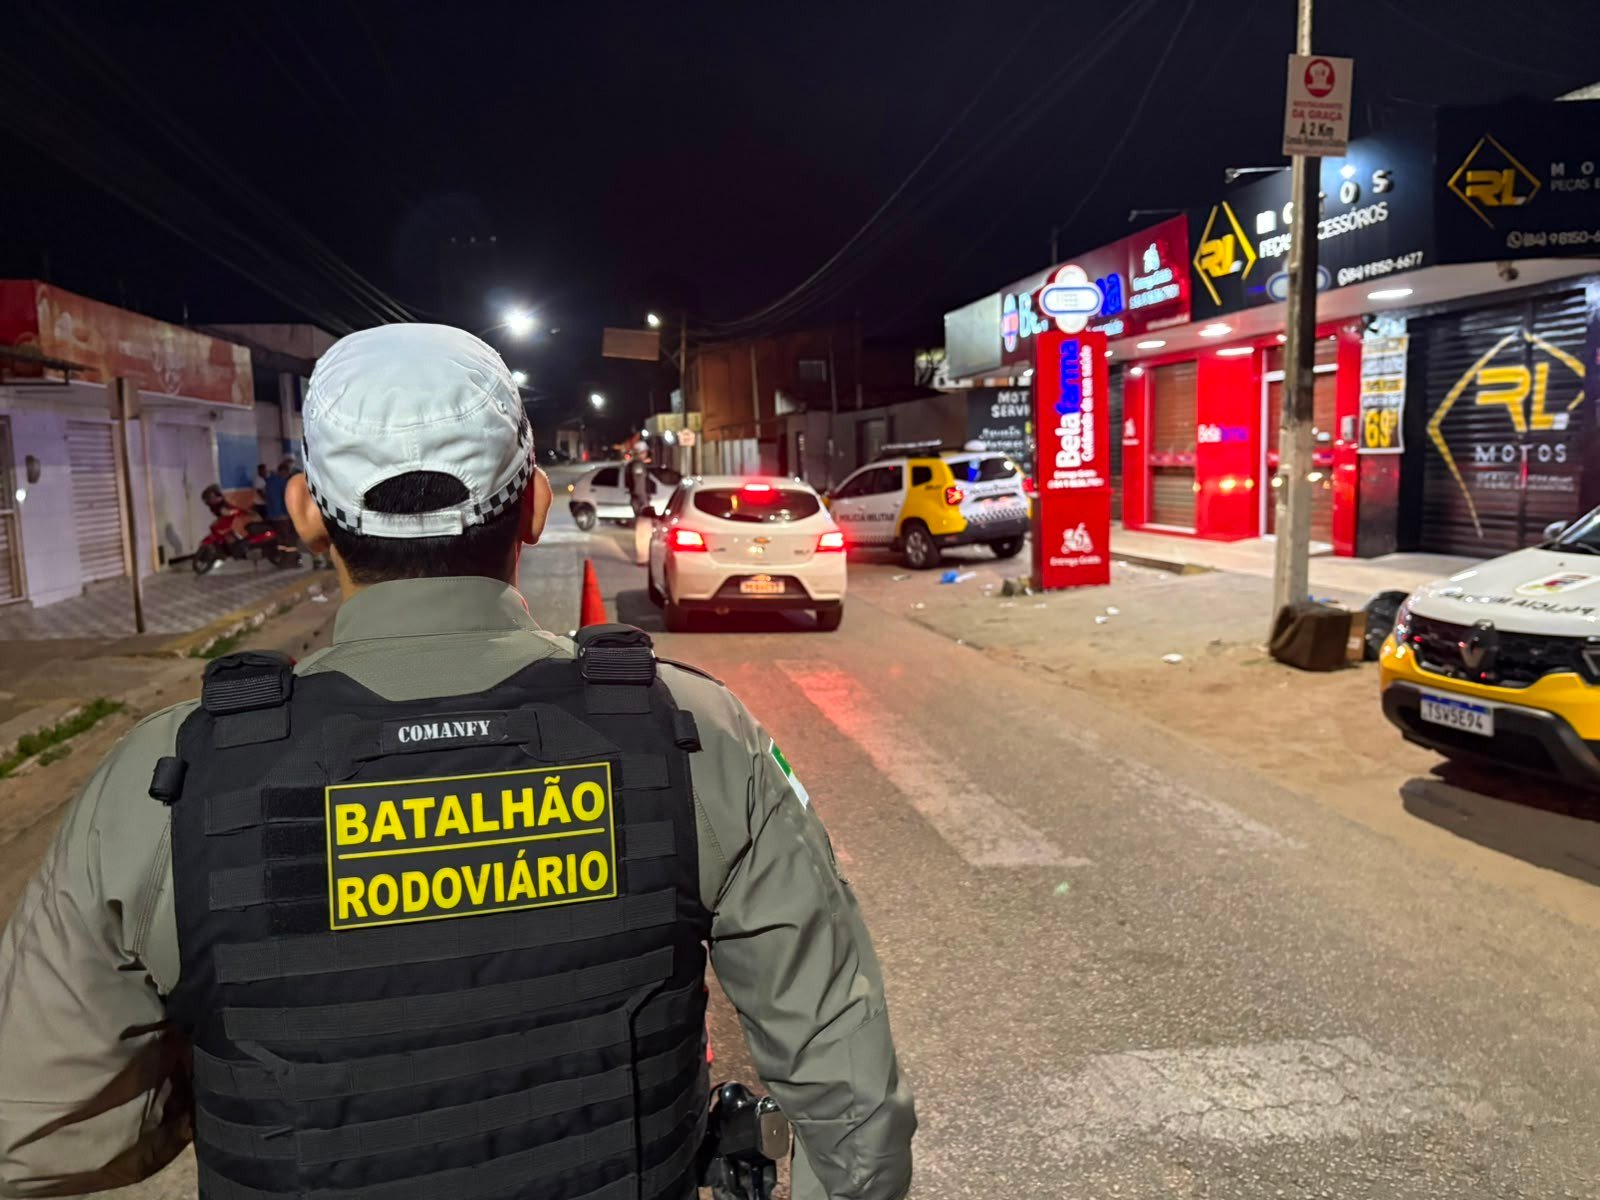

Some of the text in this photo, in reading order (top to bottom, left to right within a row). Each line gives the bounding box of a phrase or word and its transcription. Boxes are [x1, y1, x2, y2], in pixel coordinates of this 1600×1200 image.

[1309, 122, 1315, 136] 2
[1465, 168, 1527, 206] RL
[1316, 201, 1390, 240] CESSÓRIOS
[1200, 233, 1243, 278] RL
[991, 403, 1031, 418] SERVI
[1475, 362, 1570, 433] RL
[1474, 444, 1567, 462] MOTOS
[398, 720, 491, 743] COMANFY
[335, 775, 605, 846] BATALHÃO
[337, 849, 609, 920] RODOVIÁRIO
